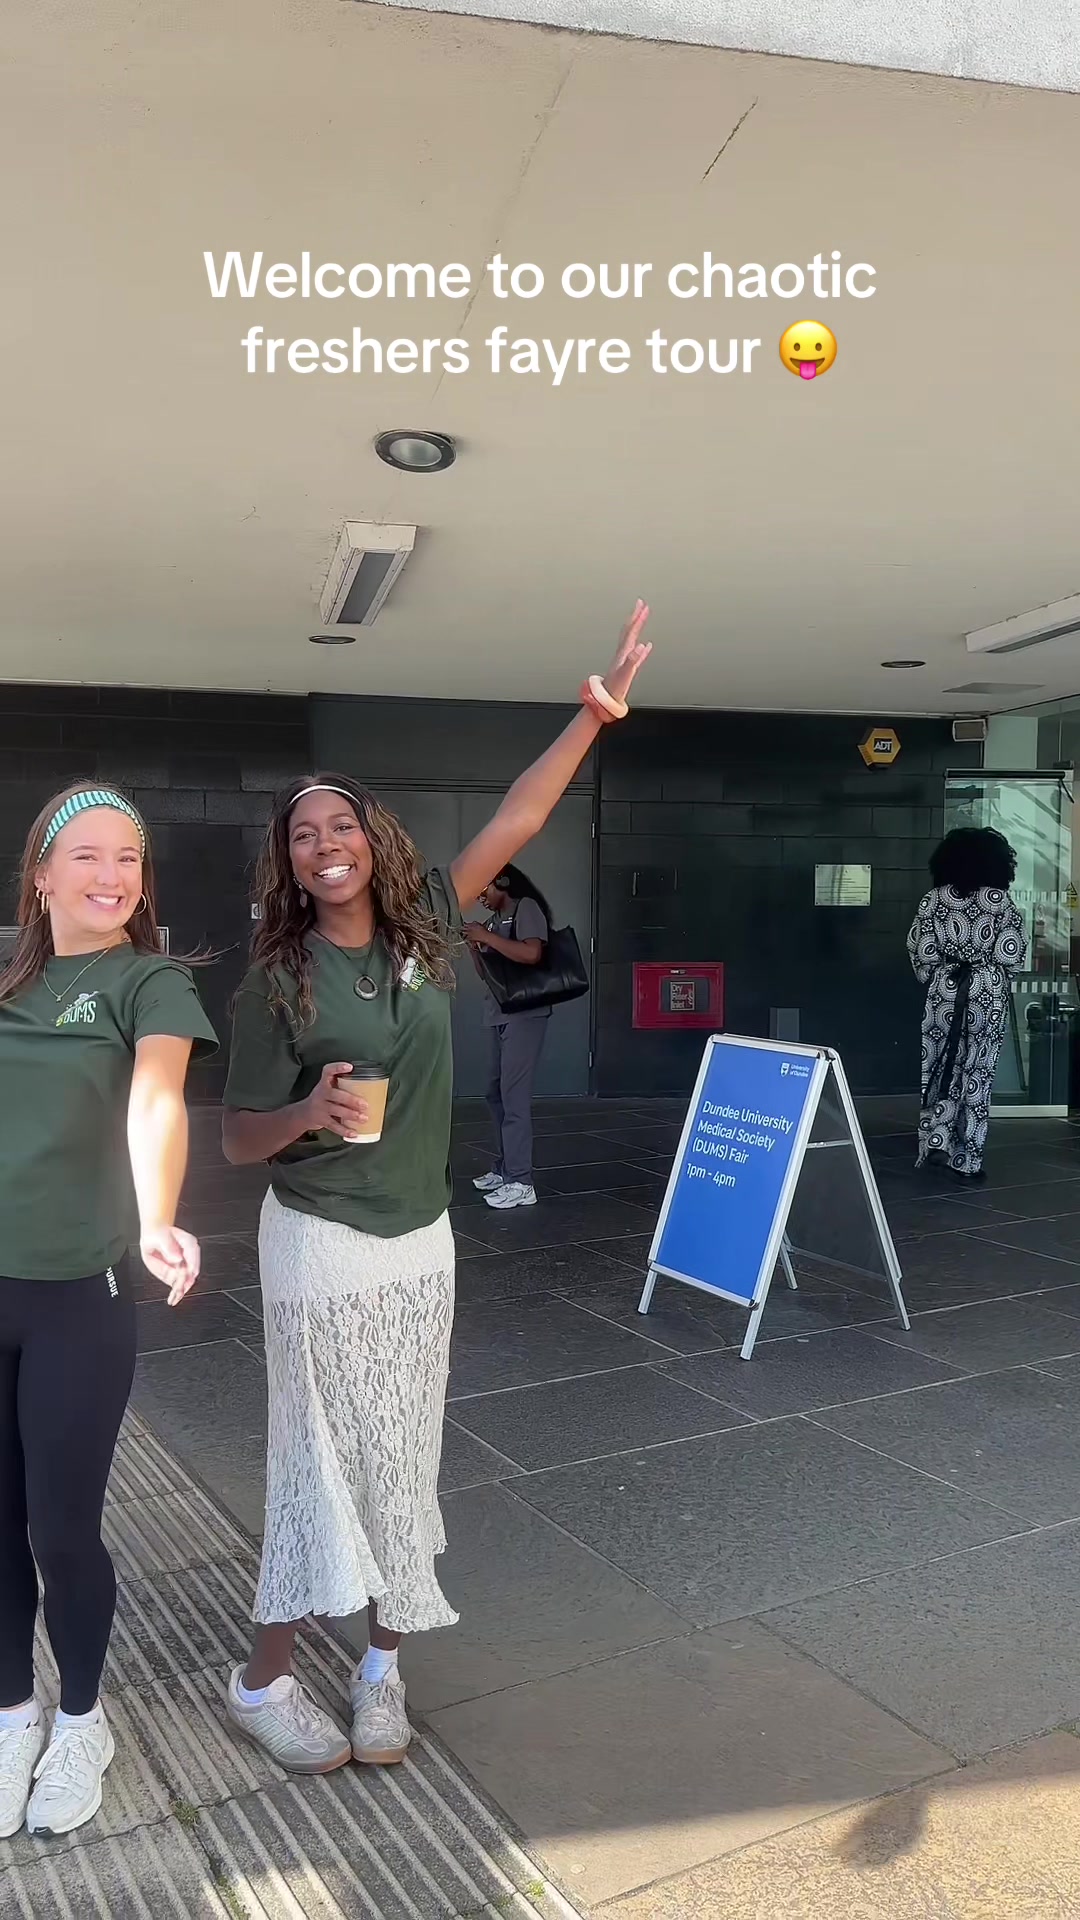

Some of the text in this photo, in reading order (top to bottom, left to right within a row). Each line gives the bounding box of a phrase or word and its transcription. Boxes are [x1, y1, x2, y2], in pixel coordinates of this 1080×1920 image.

[874, 741, 892, 751] ADT
[672, 984, 683, 994] Dry
[64, 1000, 97, 1024] DUMS
[702, 1100, 794, 1134] Dundee University
[697, 1119, 776, 1152] Medical Society
[692, 1137, 750, 1164] (DUMS) Fair
[686, 1162, 706, 1179] 1pm
[712, 1170, 736, 1188] 4pm
